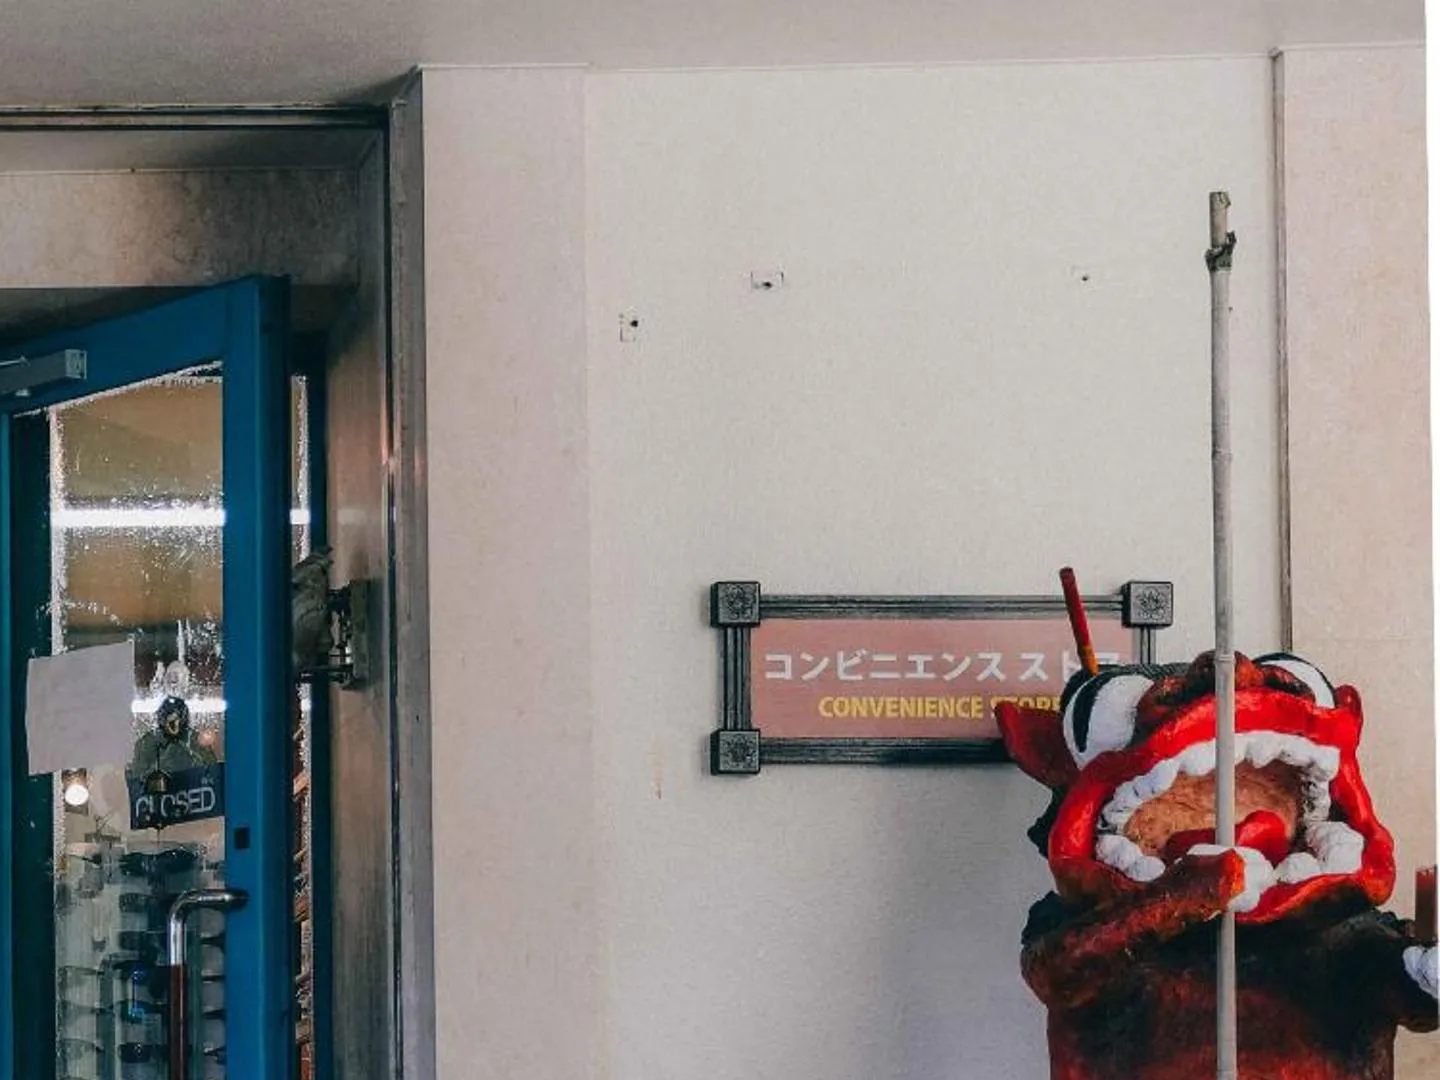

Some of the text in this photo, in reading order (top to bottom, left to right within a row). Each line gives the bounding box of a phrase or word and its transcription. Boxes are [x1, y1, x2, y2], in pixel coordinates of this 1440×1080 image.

[765, 649, 1006, 682] コンビニエンス
[818, 696, 983, 720] CONVENIENCE
